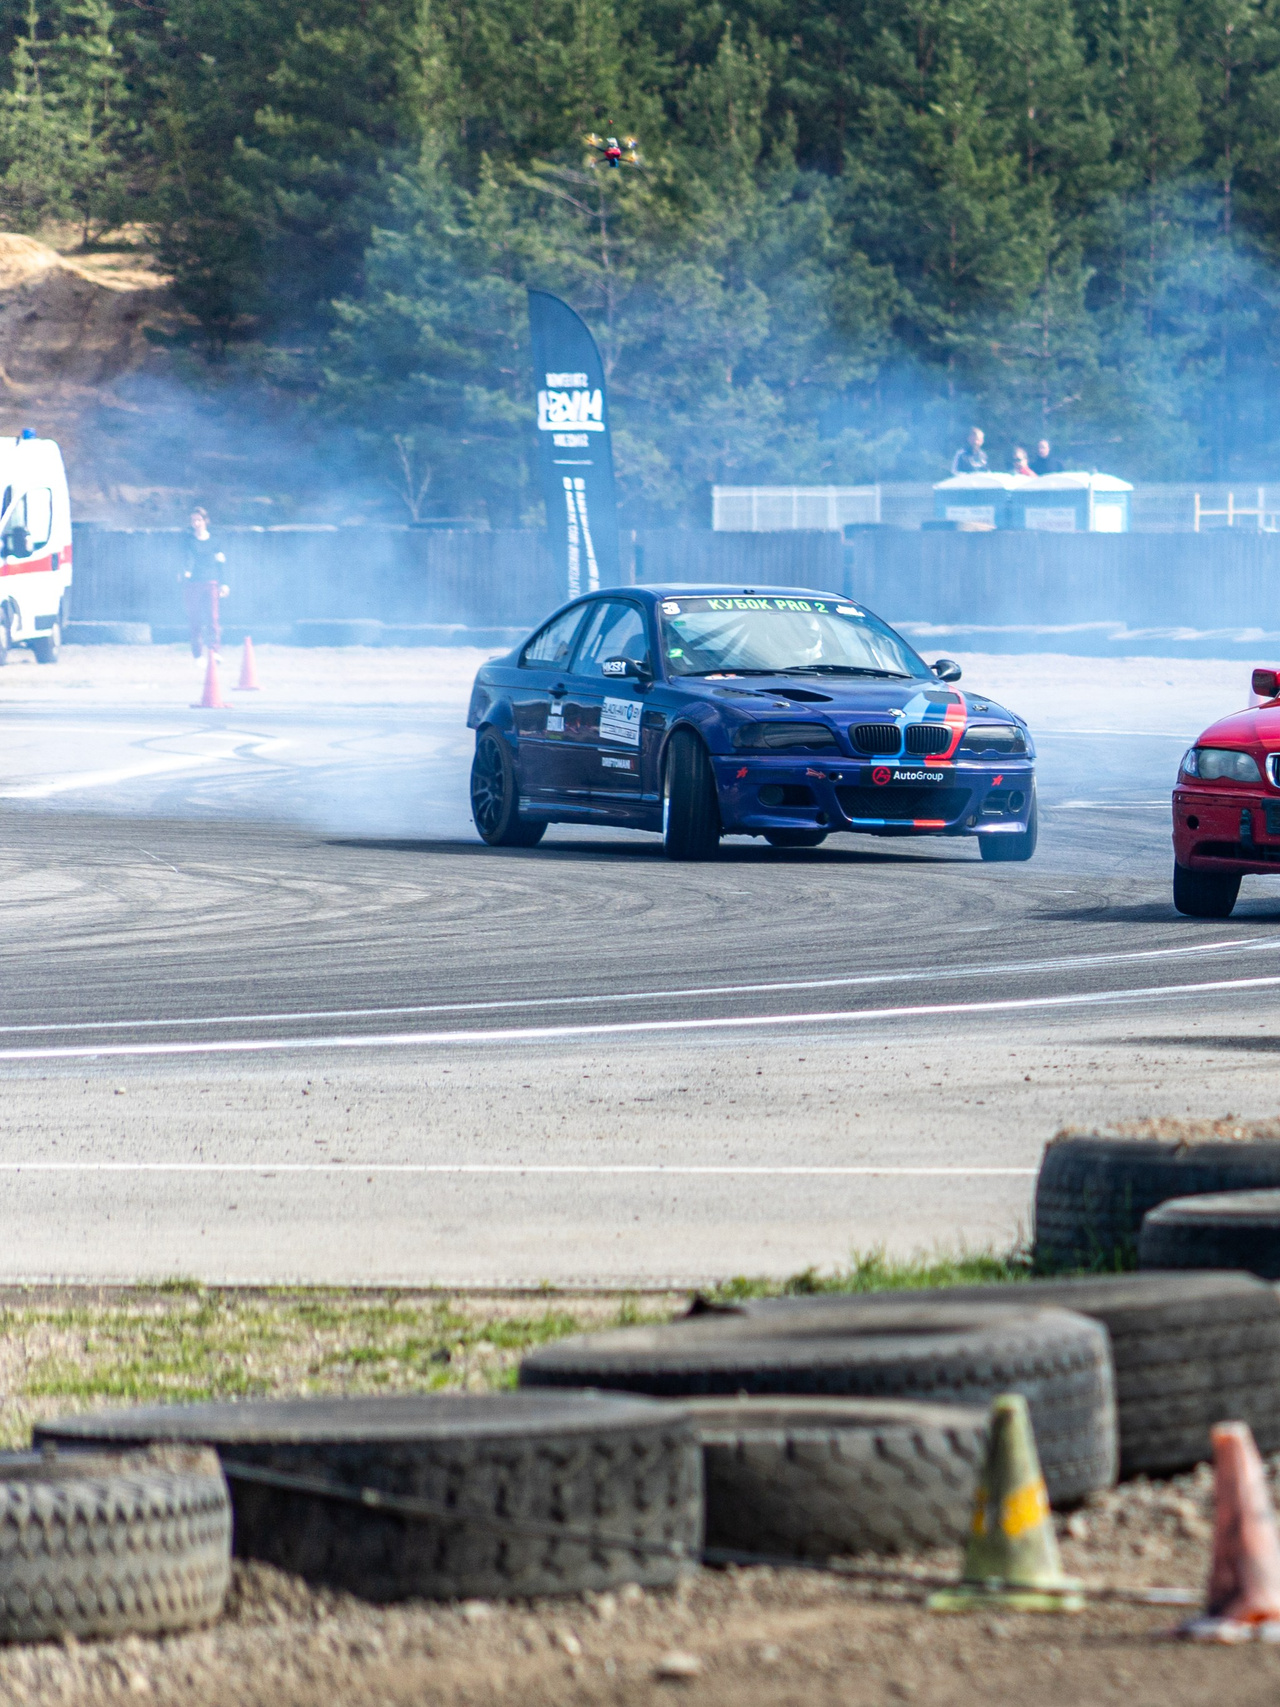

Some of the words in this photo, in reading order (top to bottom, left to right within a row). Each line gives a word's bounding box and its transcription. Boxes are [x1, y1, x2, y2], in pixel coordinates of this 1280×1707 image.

[661, 602, 681, 615] 3
[707, 599, 774, 610] КУБОК
[774, 600, 812, 612] PRO
[816, 603, 829, 613] 2
[893, 771, 944, 782] AutoGroup
